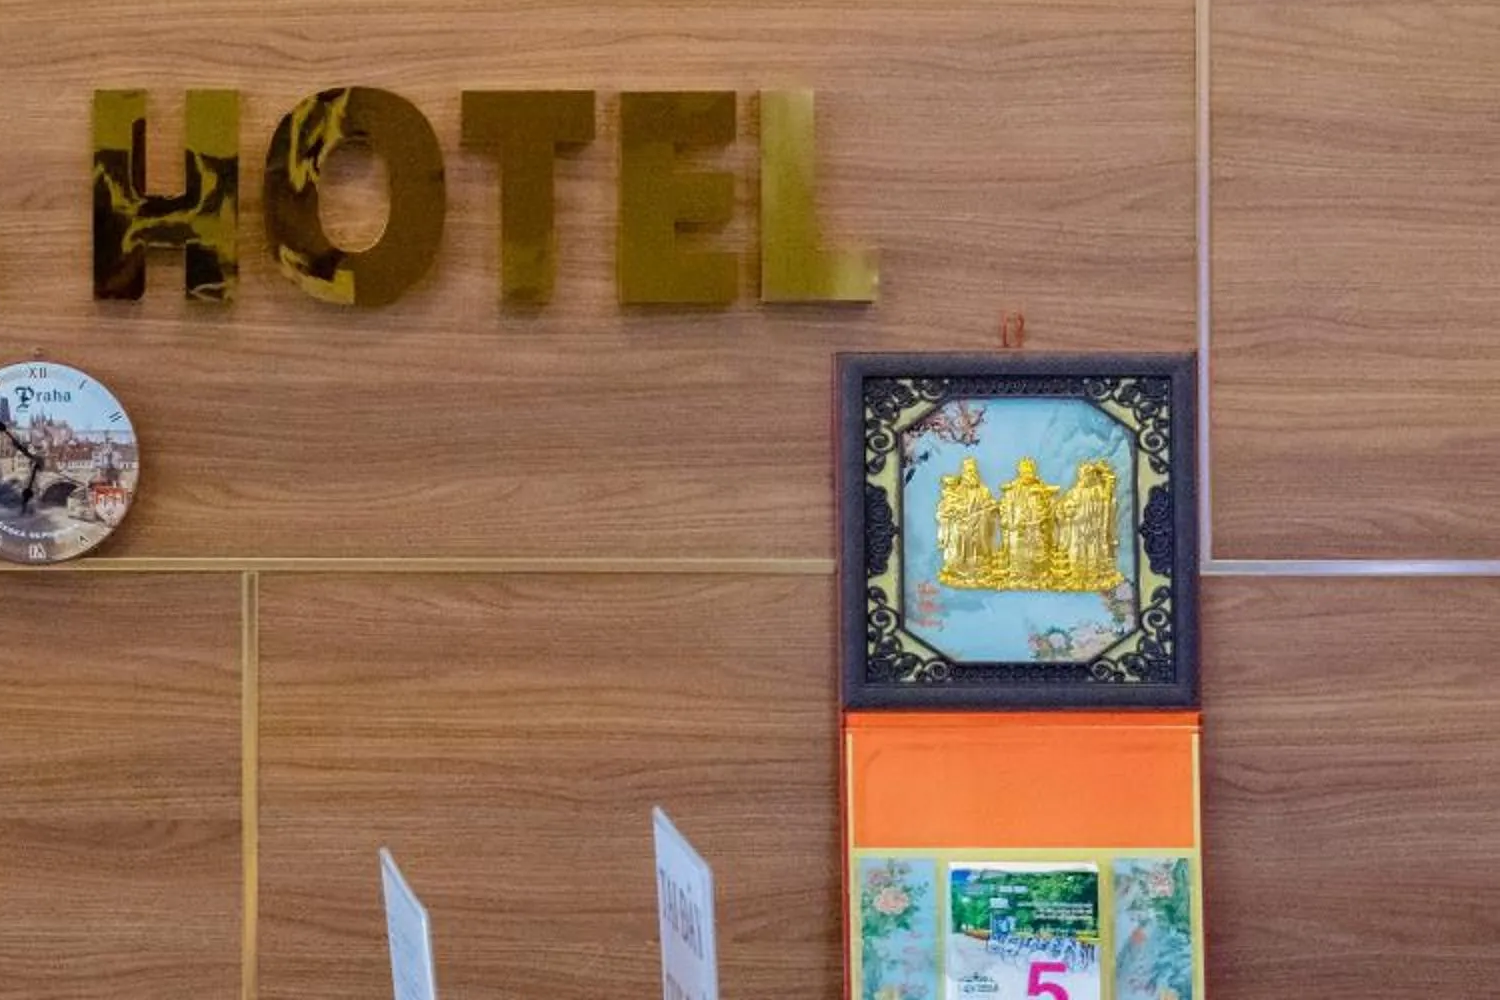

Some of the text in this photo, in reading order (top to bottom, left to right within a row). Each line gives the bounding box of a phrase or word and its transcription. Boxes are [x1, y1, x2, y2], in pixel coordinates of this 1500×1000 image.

[92, 86, 880, 306] HOTEL
[29, 367, 47, 379] XII
[14, 386, 72, 411] Praha
[1027, 961, 1069, 1000] 5
